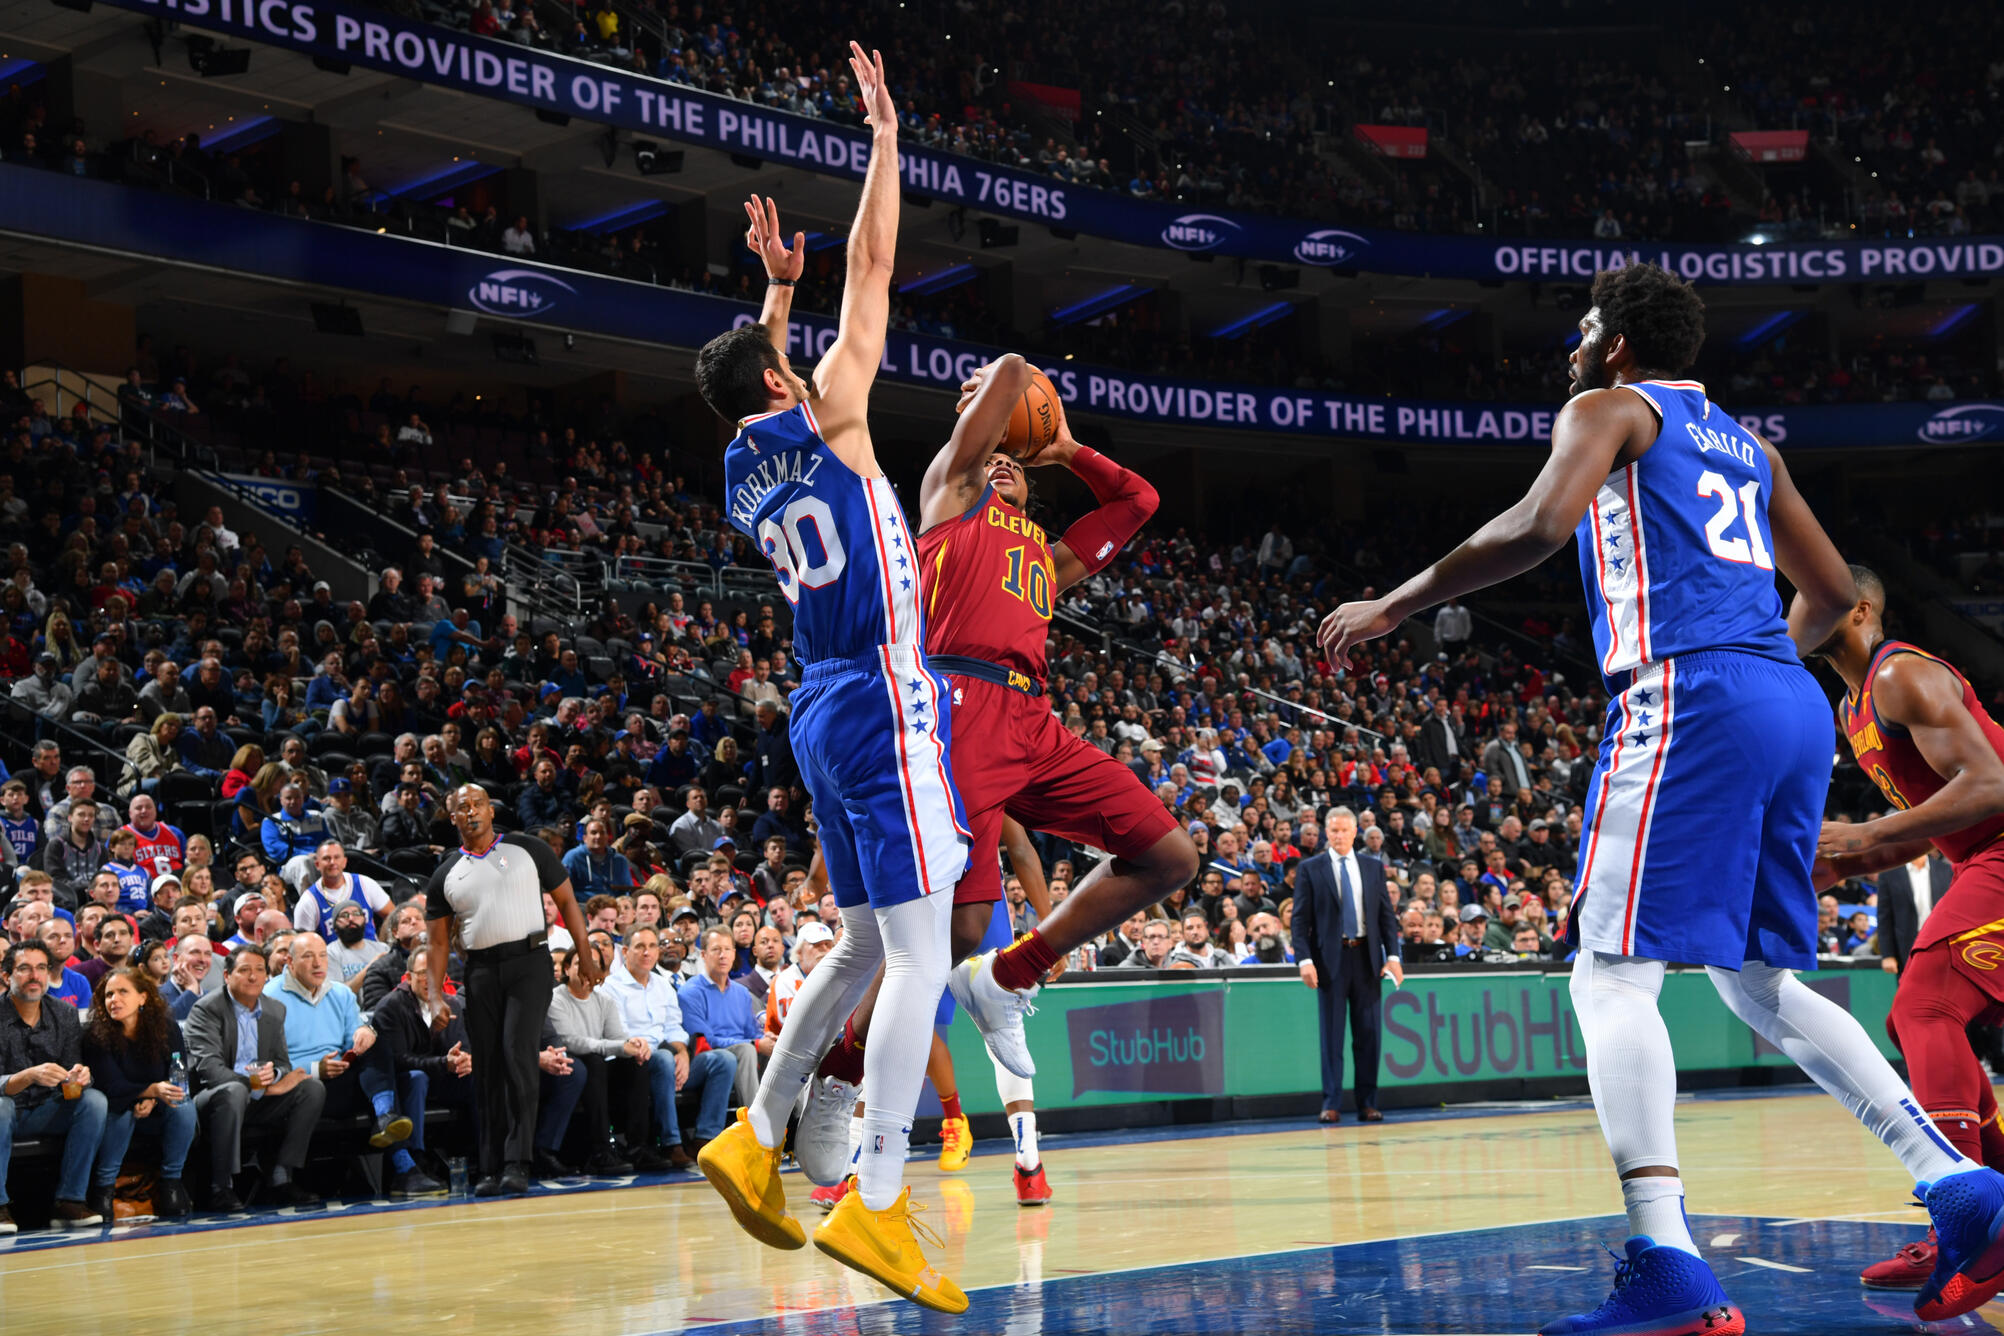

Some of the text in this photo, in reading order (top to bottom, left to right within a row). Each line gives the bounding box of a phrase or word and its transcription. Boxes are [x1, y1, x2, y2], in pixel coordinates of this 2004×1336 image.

[336, 14, 556, 102] PROVIDER
[572, 75, 621, 114] OF
[635, 89, 705, 136] THE
[718, 109, 964, 196] PHILADEHIA
[975, 171, 1067, 219] 76ERS
[479, 282, 529, 308] NFI
[1089, 375, 1258, 423] PROVIDER
[1270, 396, 1313, 427] OF
[1325, 401, 1386, 434] THE
[1397, 407, 1552, 440] PHILADE
[732, 451, 823, 528] KORKMAZ
[1697, 470, 1774, 571] 21
[757, 495, 847, 605] 30
[1001, 545, 1053, 620] 10
[1008, 670, 1031, 692] CAVS
[135, 845, 180, 863] SIXERS
[153, 856, 173, 876] 6
[129, 887, 147, 900] 25
[1089, 1026, 1207, 1067] StubHub
[1383, 988, 1589, 1079] StubHu
